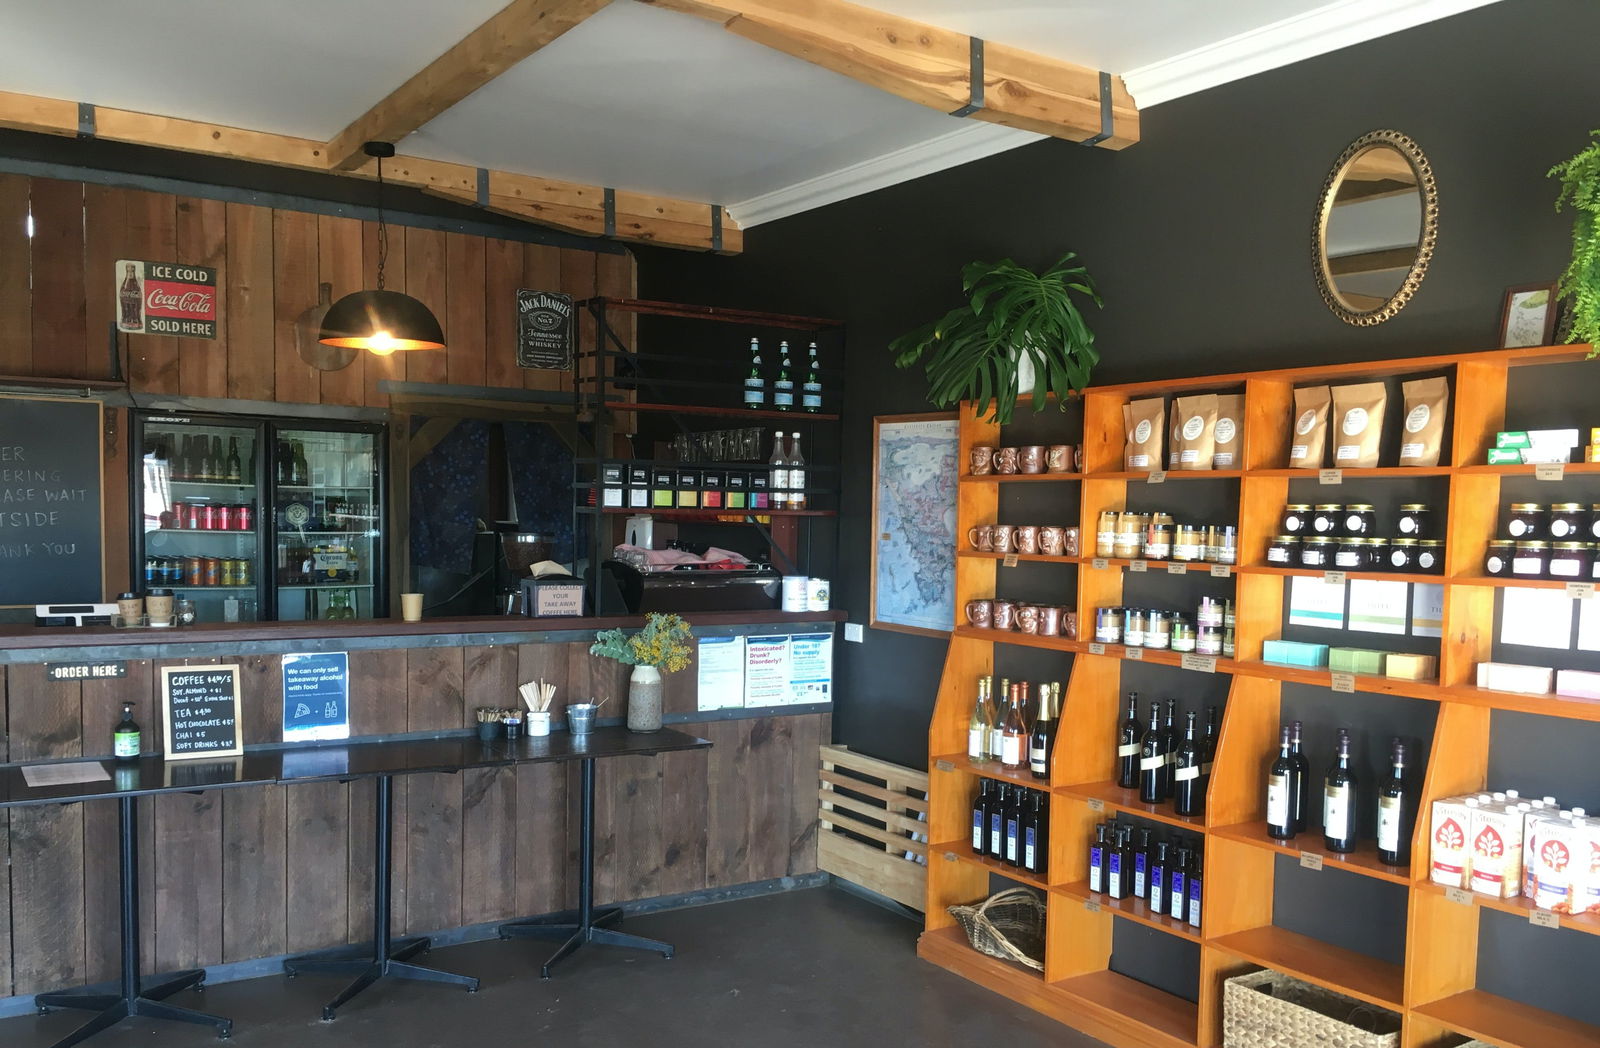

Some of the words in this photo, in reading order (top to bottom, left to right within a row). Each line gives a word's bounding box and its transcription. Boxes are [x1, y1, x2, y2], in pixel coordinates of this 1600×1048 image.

[152, 266, 172, 278] ICE
[176, 269, 208, 282] COLD
[520, 298, 540, 313] JACK
[540, 295, 572, 318] DANIEL'S
[150, 320, 180, 332] SOLD
[182, 322, 211, 335] HERE
[528, 341, 562, 349] WHISKEY
[45, 489, 87, 503] WAIT
[42, 543, 76, 556] YOU
[55, 666, 89, 679] ORDER
[92, 665, 118, 677] HERE
[172, 675, 205, 686] COFFEE
[287, 676, 318, 684] takeaway
[174, 708, 192, 719] TEA
[175, 720, 188, 730] HOT
[188, 719, 221, 729] CHOCOLATE
[175, 731, 193, 740] CHAI
[176, 742, 192, 750] SOFT
[194, 741, 218, 749] DRINKS
